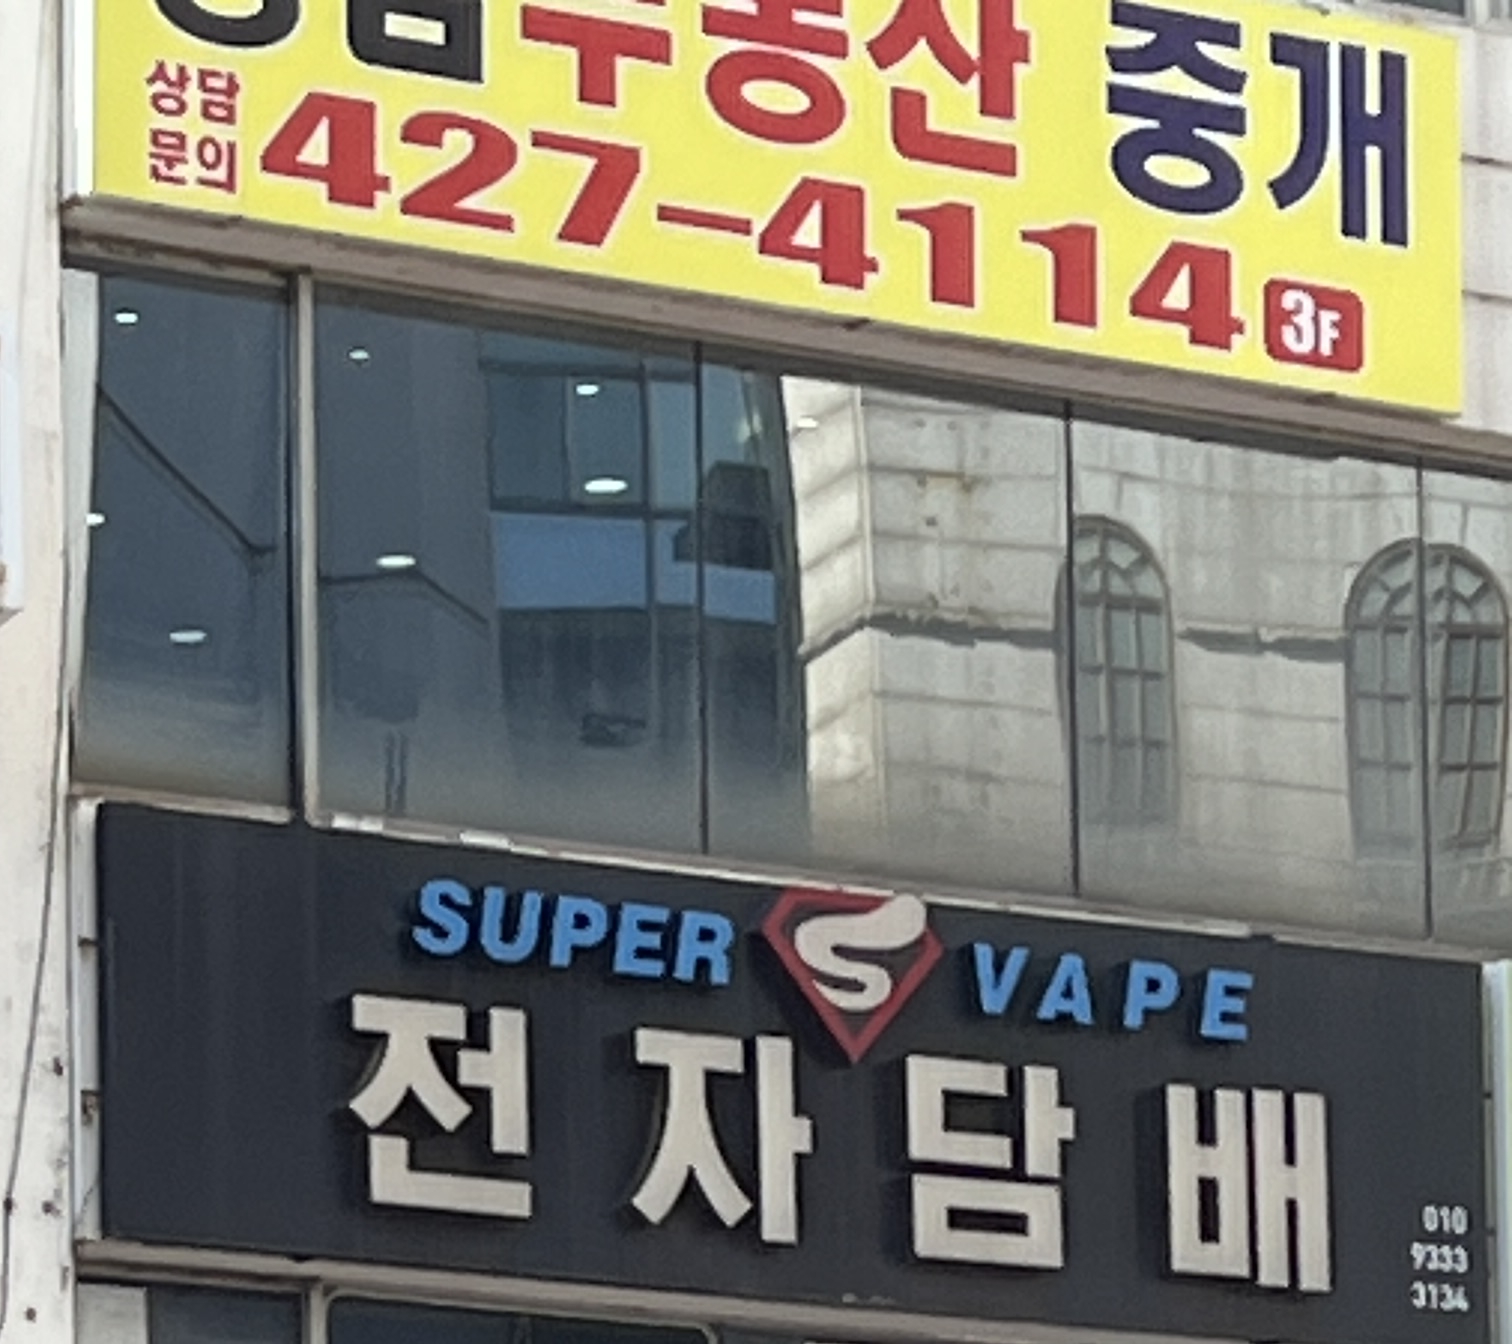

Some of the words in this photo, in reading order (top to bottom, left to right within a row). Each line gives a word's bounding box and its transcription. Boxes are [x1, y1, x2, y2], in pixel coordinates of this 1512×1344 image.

[146, 60, 240, 126] 상담
[149, 127, 237, 194] 문의
[1105, 0, 1409, 248] 중개
[260, 91, 1244, 353] 427-4114
[1280, 288, 1342, 358] 3F
[412, 880, 734, 986] SUPER
[972, 942, 1254, 1043] VAPE
[349, 994, 1332, 1293] 전자담배
[1422, 1205, 1468, 1234] 010
